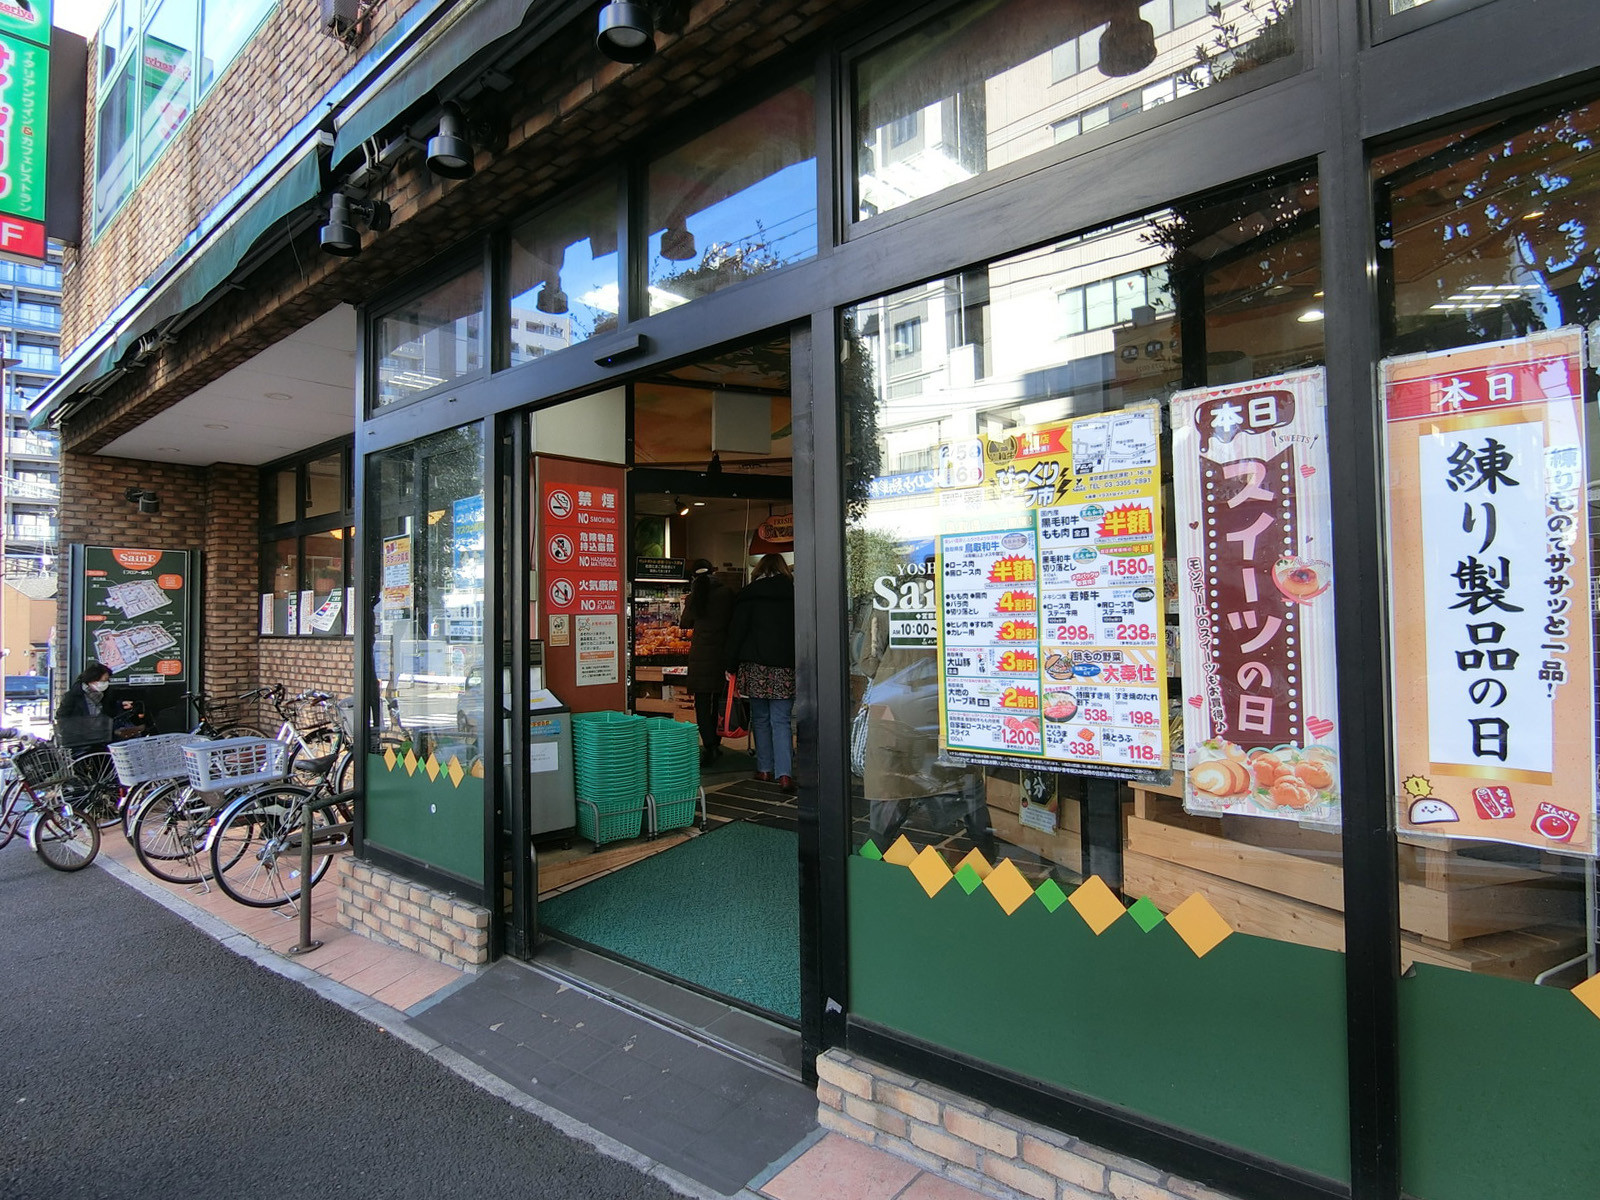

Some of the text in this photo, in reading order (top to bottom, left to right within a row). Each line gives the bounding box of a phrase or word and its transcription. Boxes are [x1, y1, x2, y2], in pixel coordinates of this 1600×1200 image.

[1436, 373, 1514, 410] 本日
[1210, 396, 1277, 432] 本日
[1278, 435, 1311, 444] SWEETS
[995, 461, 1060, 492] びっくり
[578, 491, 615, 508] 禁煙
[577, 513, 616, 524] NO SMOKING
[1041, 515, 1080, 528] 黒毛和牛
[1104, 509, 1151, 536] 半額
[1042, 528, 1070, 539] もも肉
[119, 553, 157, 563] SainE
[579, 556, 590, 567] NO
[994, 559, 1034, 582] 半額
[1042, 563, 1077, 572] 切り落とし
[579, 580, 618, 591] 火気厳禁
[1000, 591, 1036, 612] 4割引
[1221, 460, 1283, 735] スイーツの日
[1445, 437, 1525, 762] 練り製品の日
[580, 600, 596, 611] NO
[1002, 620, 1037, 640] 3割引
[1056, 625, 1095, 641] 298円
[1116, 623, 1157, 640] 238円
[1002, 650, 1038, 672] 3割引
[1072, 651, 1122, 662] 鍋もの野菜
[1103, 664, 1156, 683] 大奉仕
[1004, 686, 1039, 709] 2割引
[1114, 692, 1158, 701] すき焼のたれ
[1084, 708, 1113, 722] 538円
[1129, 711, 1160, 725] 198円
[1046, 737, 1065, 745] キムチ
[1102, 733, 1133, 743] 焼とうふ
[1069, 741, 1101, 756] 338円
[1127, 745, 1160, 760] 118円
[1495, 788, 1515, 815] ちくわ
[1539, 803, 1579, 822] はんぺん
